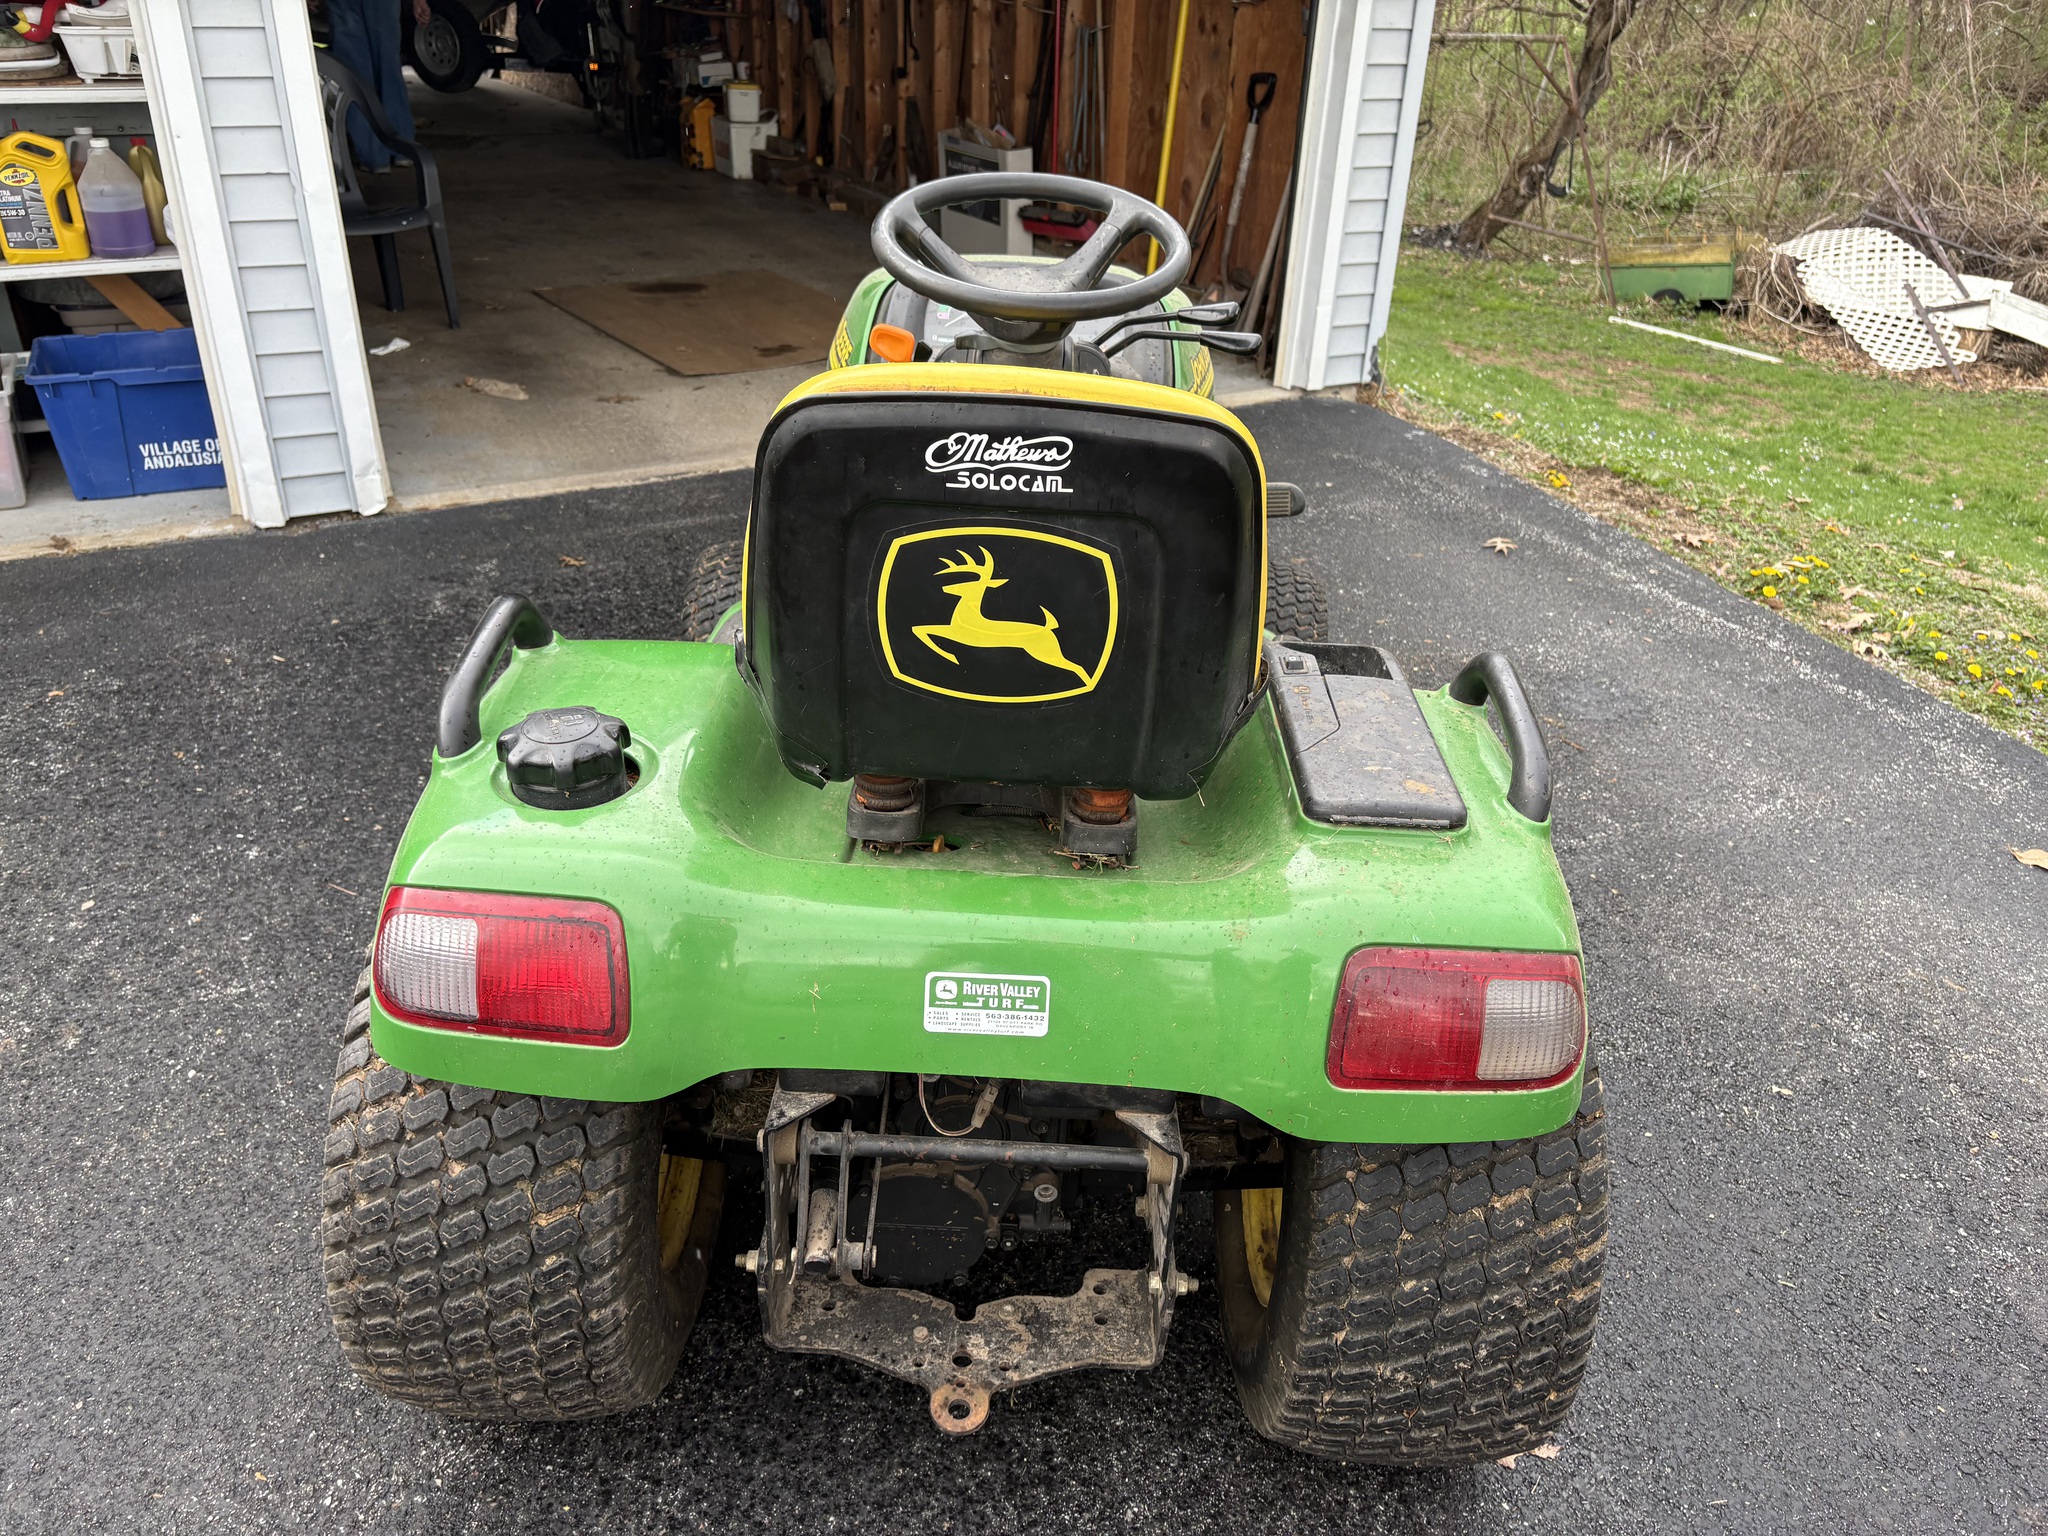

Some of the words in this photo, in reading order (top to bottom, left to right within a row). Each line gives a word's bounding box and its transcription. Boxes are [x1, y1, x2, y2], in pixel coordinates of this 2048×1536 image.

[3, 171, 30, 182] PENNZOIL
[139, 439, 202, 457] VILLAGE
[925, 432, 1074, 468] Mathews
[946, 471, 1074, 493] SOLOCAM
[963, 981, 999, 996] RIVER
[1000, 983, 1041, 998] VALLEY
[975, 997, 1026, 1009] TURF
